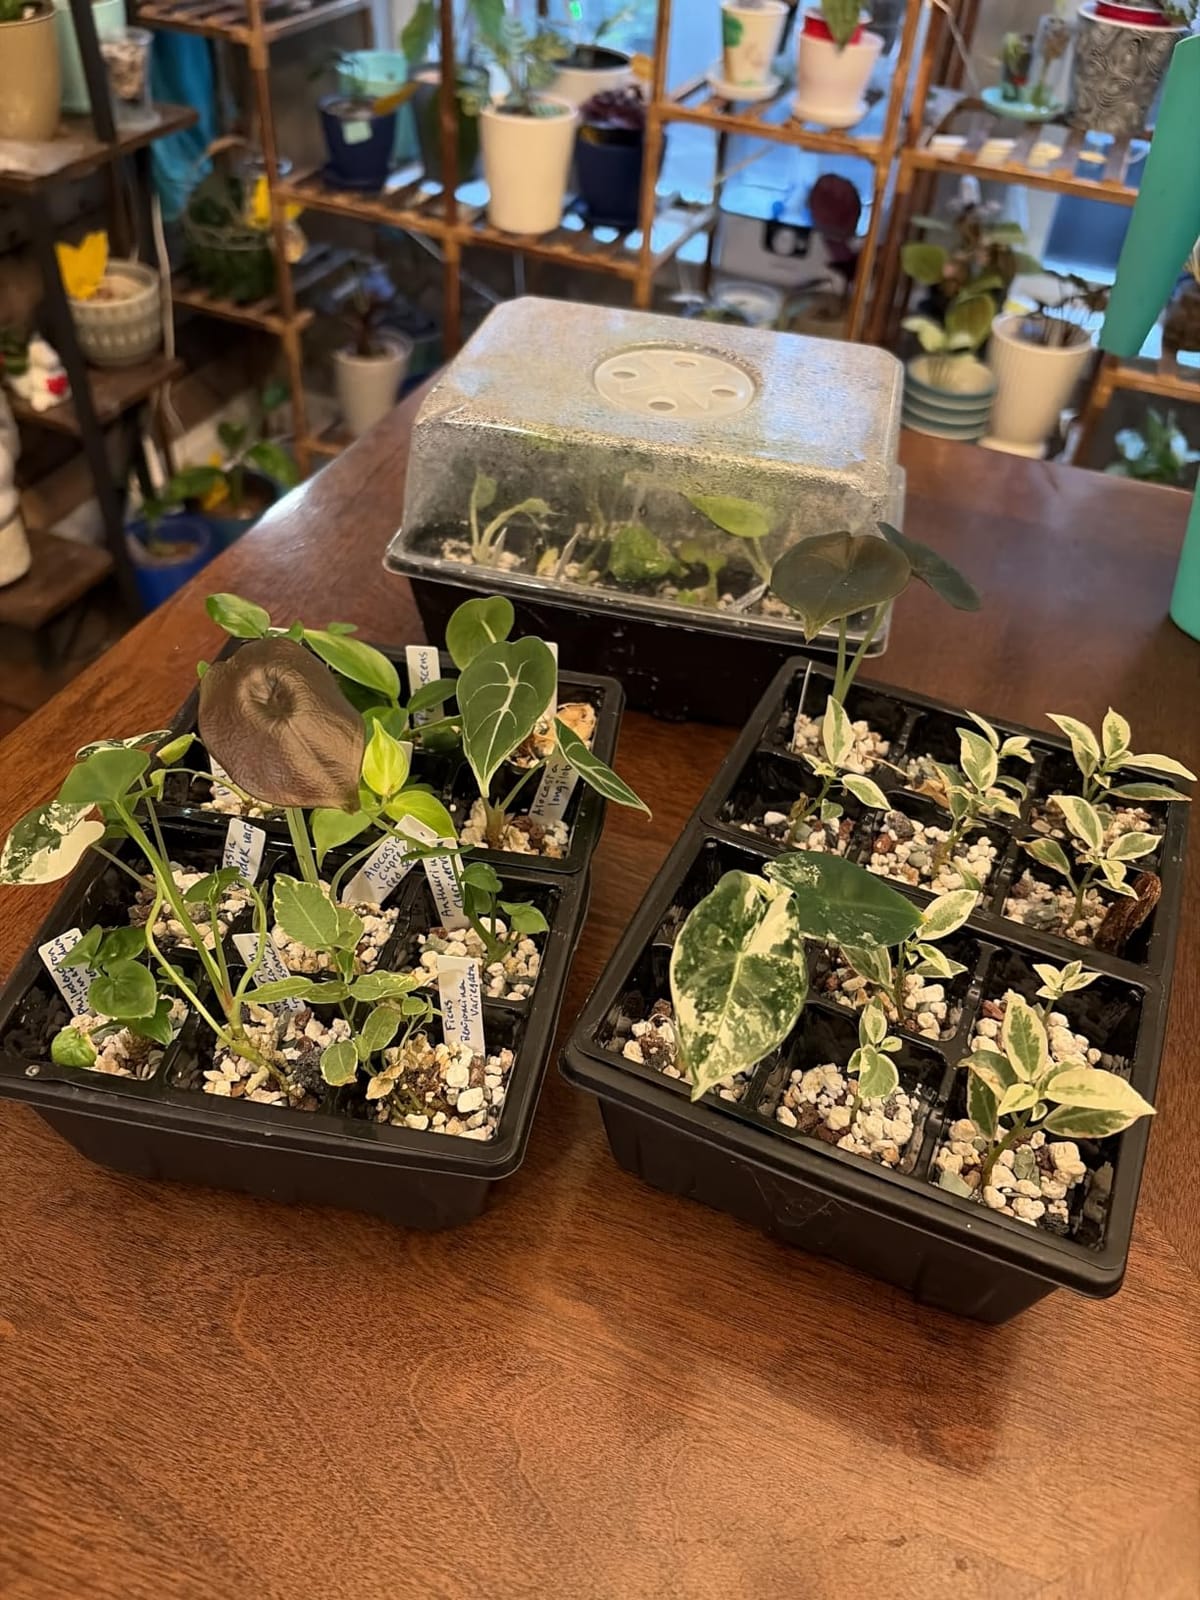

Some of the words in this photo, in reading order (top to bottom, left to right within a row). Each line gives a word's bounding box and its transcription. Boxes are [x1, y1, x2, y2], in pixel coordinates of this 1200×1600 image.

[547, 764, 573, 806] longilob
[429, 858, 455, 917] Anthuriu
[444, 999, 457, 1031] Ficus
